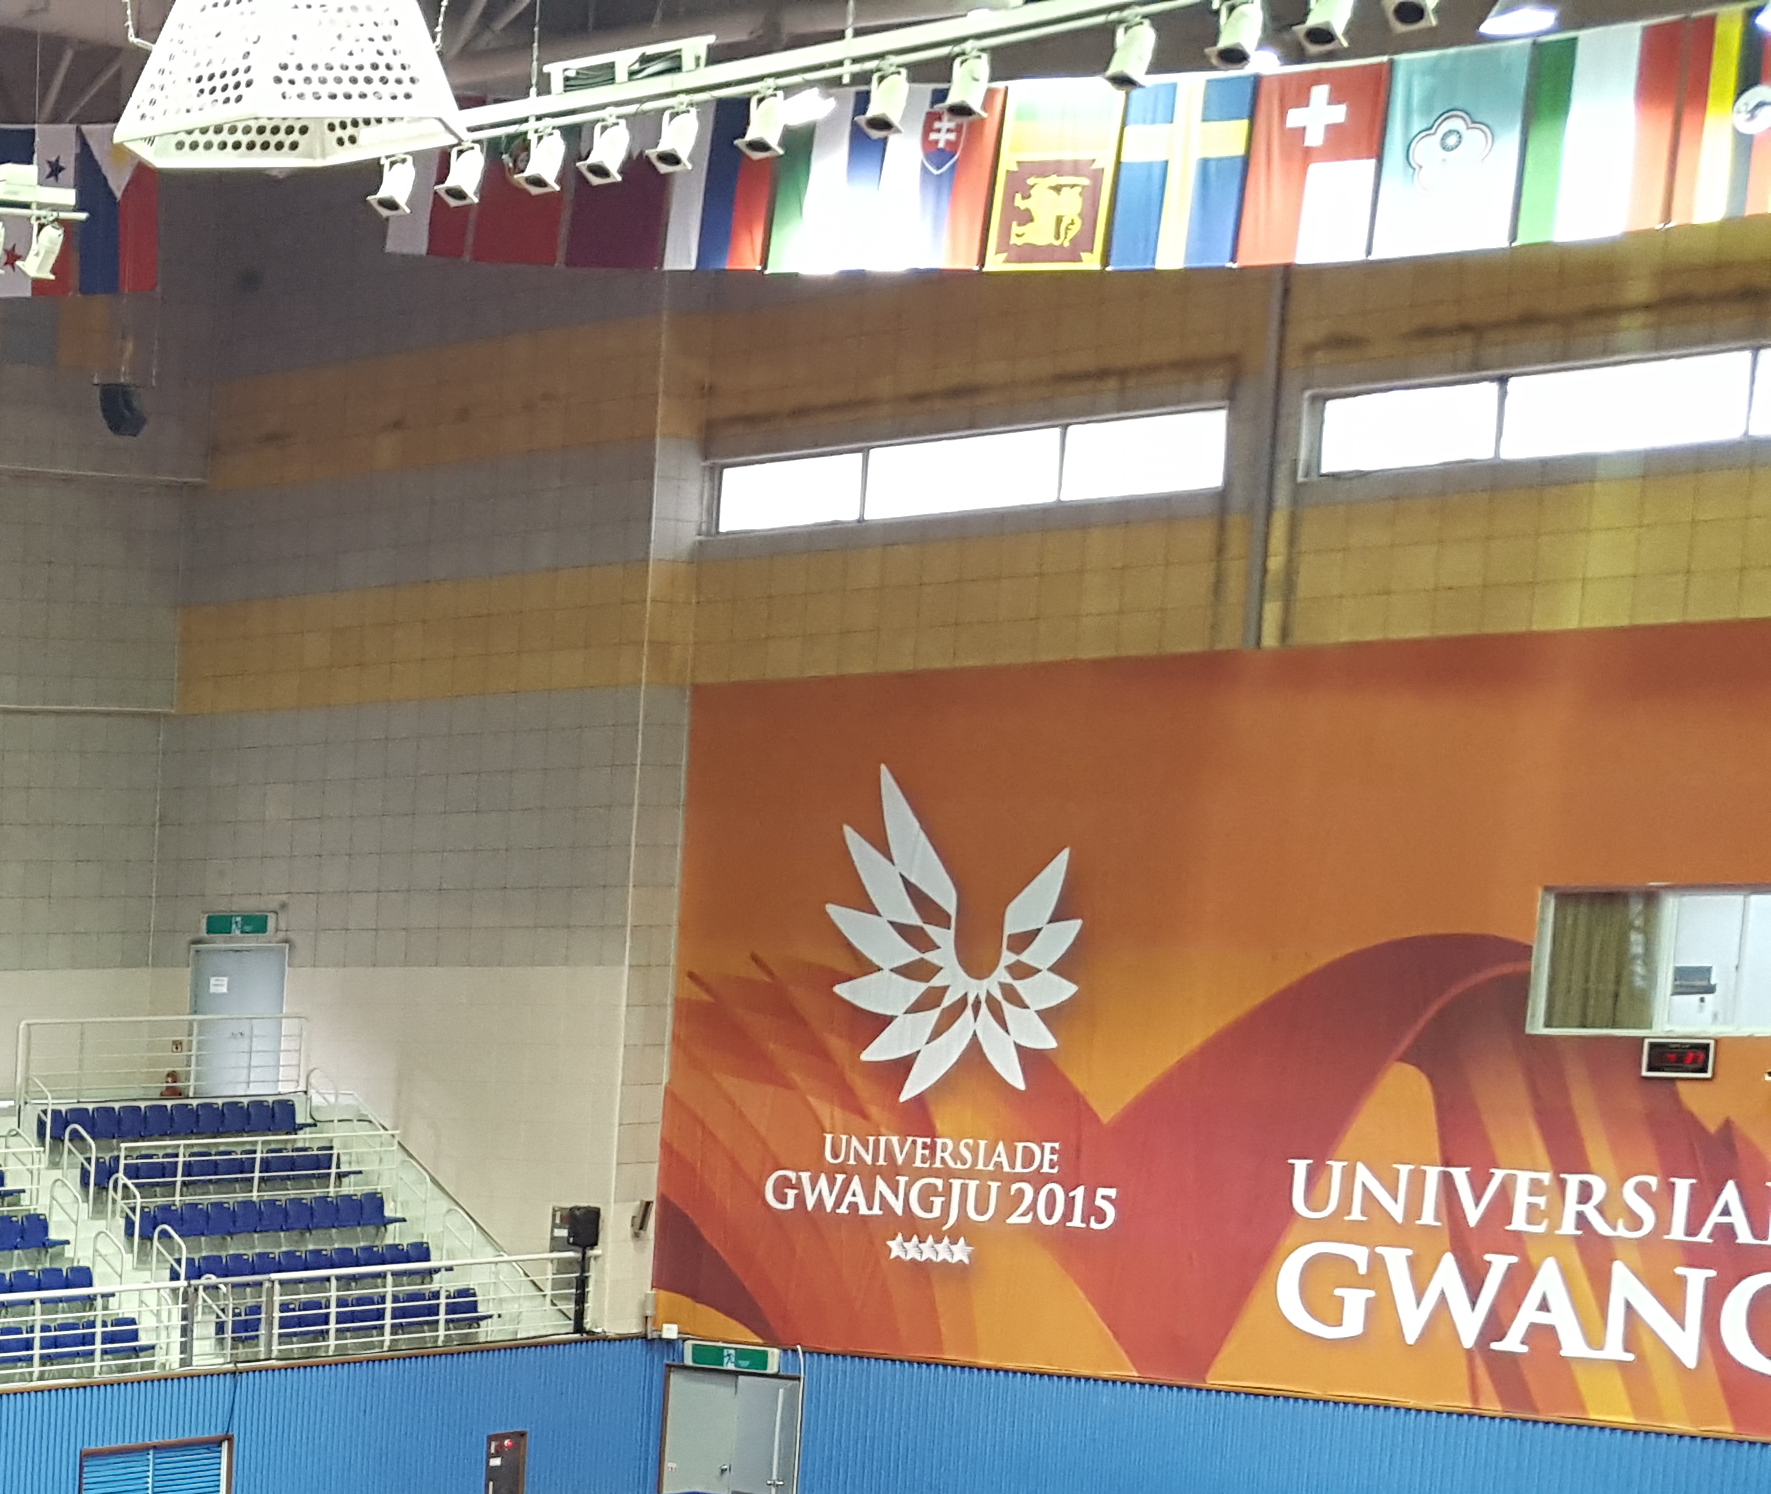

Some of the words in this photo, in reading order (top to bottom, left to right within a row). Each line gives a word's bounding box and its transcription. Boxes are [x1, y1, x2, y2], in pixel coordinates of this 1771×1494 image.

[822, 1133, 1060, 1175] UNIVERSIADE
[764, 1171, 1001, 1230] GWANGJU
[1007, 1182, 1117, 1229] 2015
[1287, 1159, 1771, 1245] UNIVERSIA
